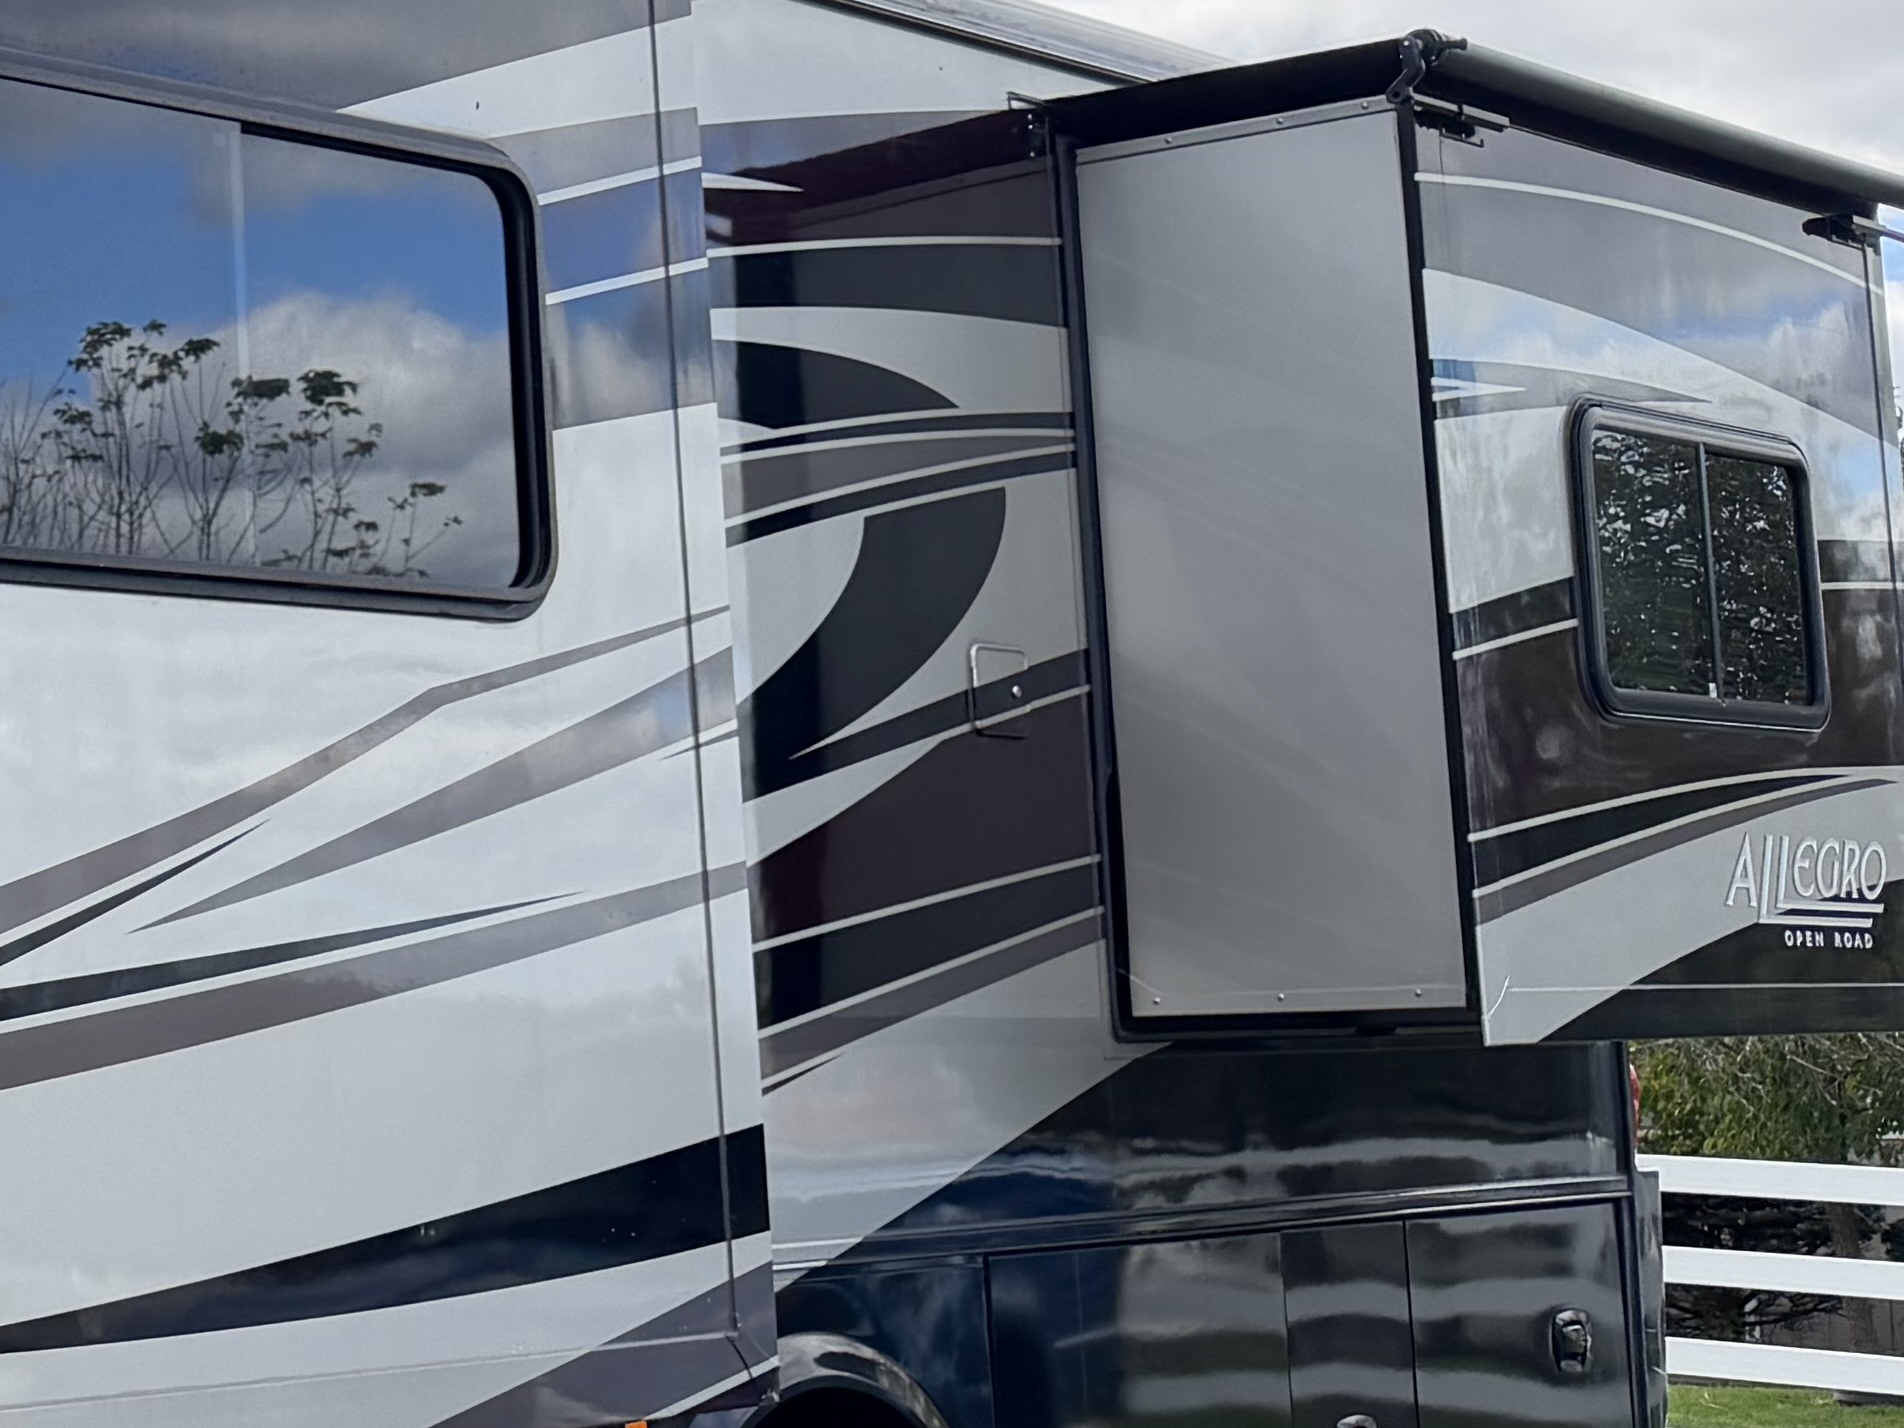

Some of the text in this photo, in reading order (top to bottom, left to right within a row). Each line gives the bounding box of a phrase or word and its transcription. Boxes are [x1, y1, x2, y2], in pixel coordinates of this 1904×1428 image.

[1725, 832, 1886, 927] ALLEGRO
[1784, 930, 1874, 948] OPEN ROAD
